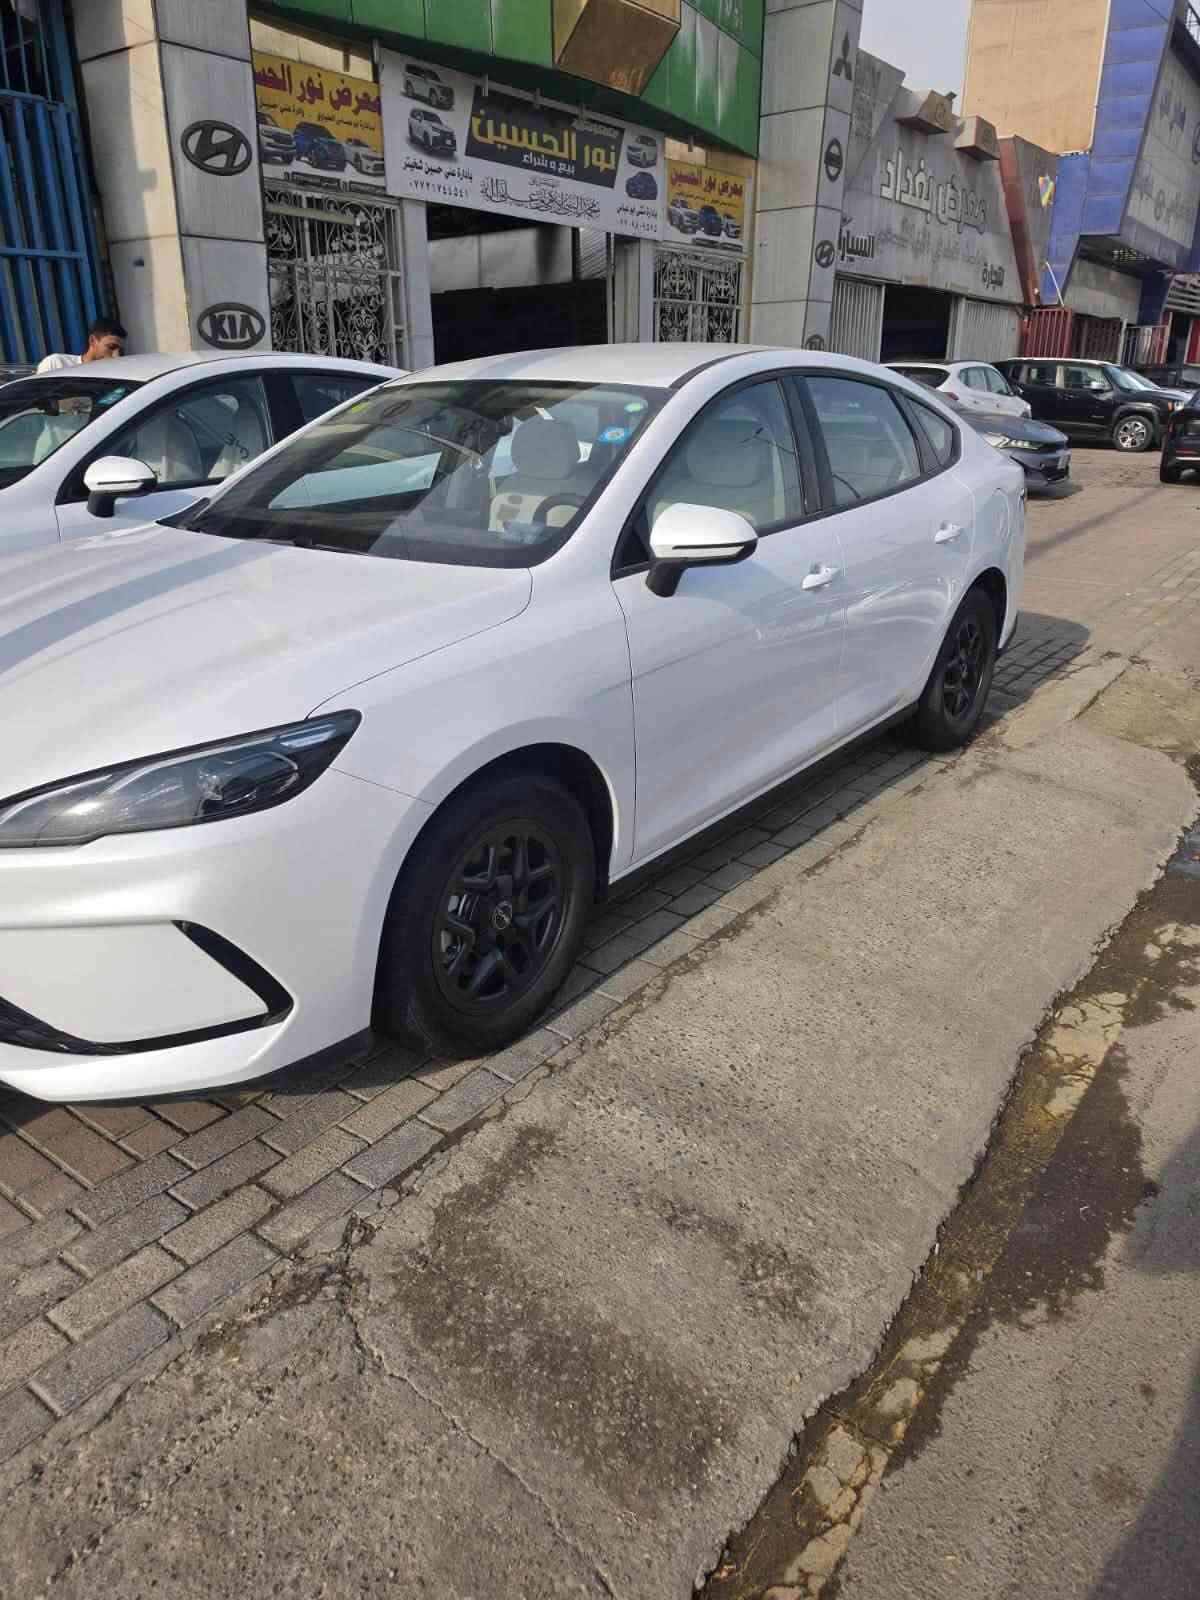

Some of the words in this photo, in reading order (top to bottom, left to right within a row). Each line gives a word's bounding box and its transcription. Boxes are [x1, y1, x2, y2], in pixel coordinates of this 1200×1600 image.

[297, 72, 325, 105] نور
[471, 109, 577, 161] الحسين
[521, 151, 548, 168] شراء
[557, 161, 576, 178] بيع
[583, 144, 616, 173] نور
